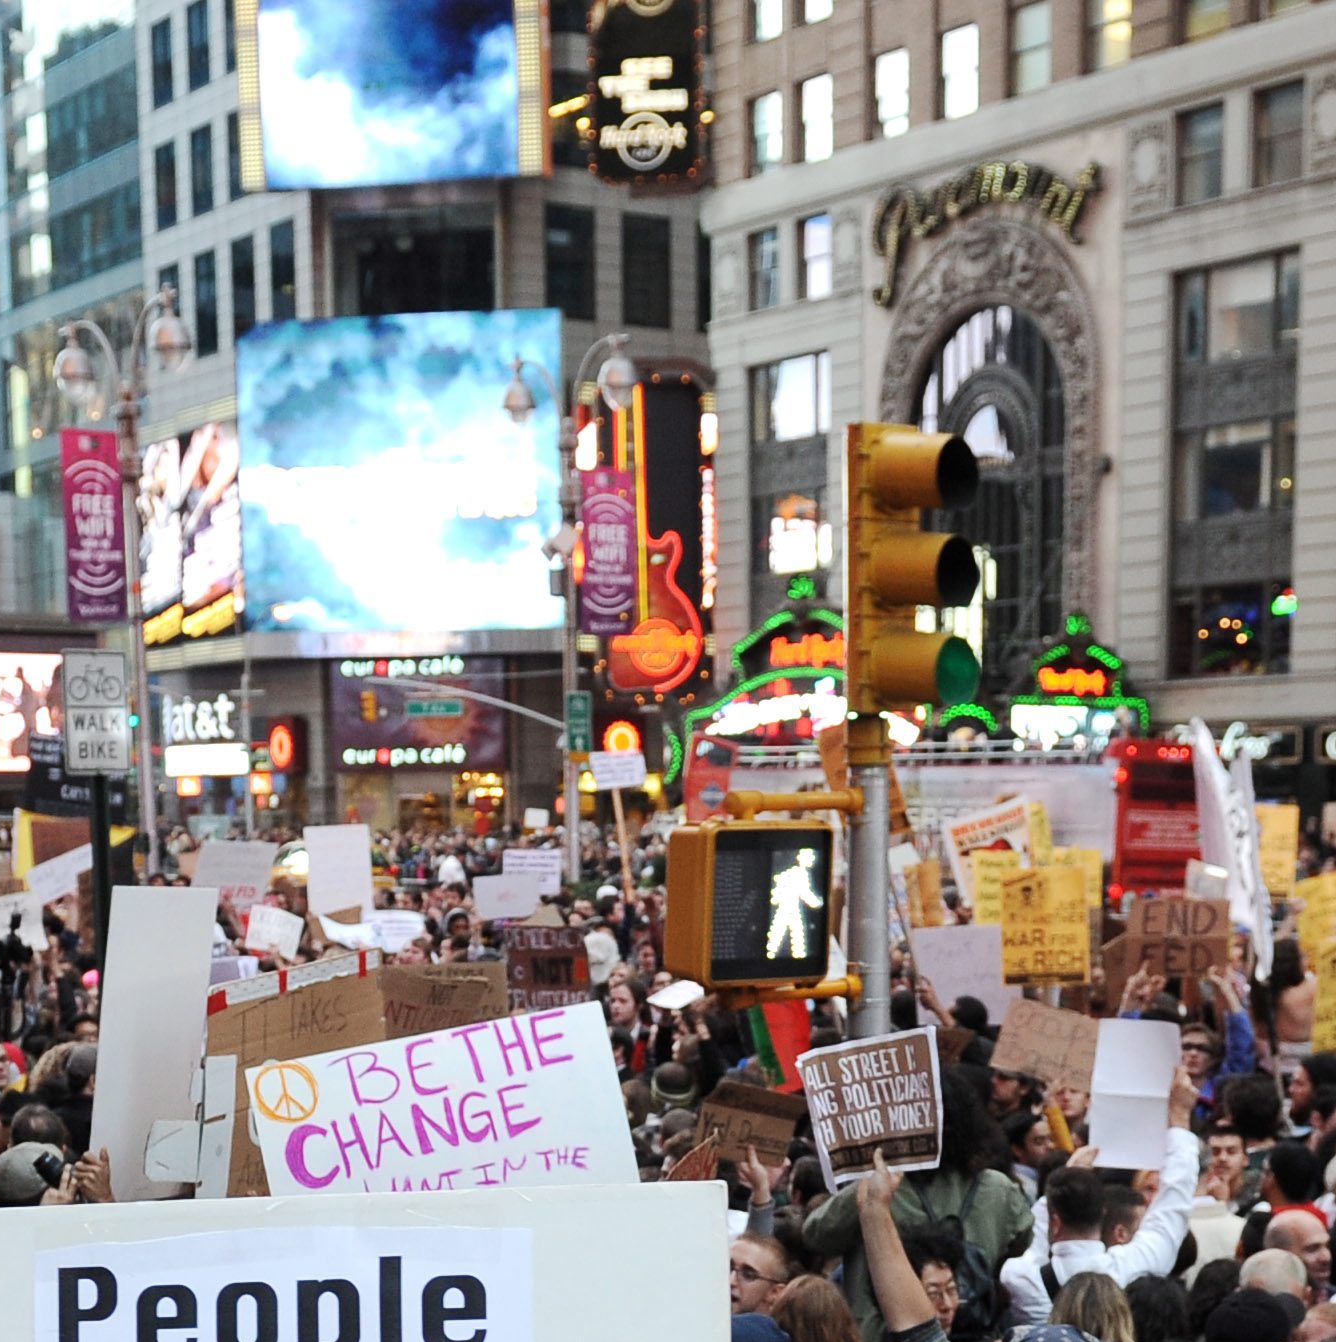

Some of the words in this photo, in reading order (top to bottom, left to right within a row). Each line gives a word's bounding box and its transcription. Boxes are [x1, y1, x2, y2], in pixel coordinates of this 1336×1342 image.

[871, 159, 1105, 308] Paramount
[341, 658, 416, 678] europa
[72, 713, 121, 732] WALK
[171, 692, 236, 742] at&t
[78, 741, 119, 759] BIKE
[342, 747, 418, 768] europa
[1142, 902, 1220, 935] END
[327, 1037, 449, 1105] BE
[452, 1009, 574, 1084] THE
[804, 1061, 836, 1091] ALL
[838, 1047, 901, 1085] STREET
[841, 1071, 931, 1112] POLITICIANS
[284, 1083, 543, 1190] CHANGE
[838, 1108, 885, 1141] YOUR
[887, 1101, 934, 1132] MONEY.
[472, 1154, 527, 1186] IN
[535, 1146, 591, 1172] THE
